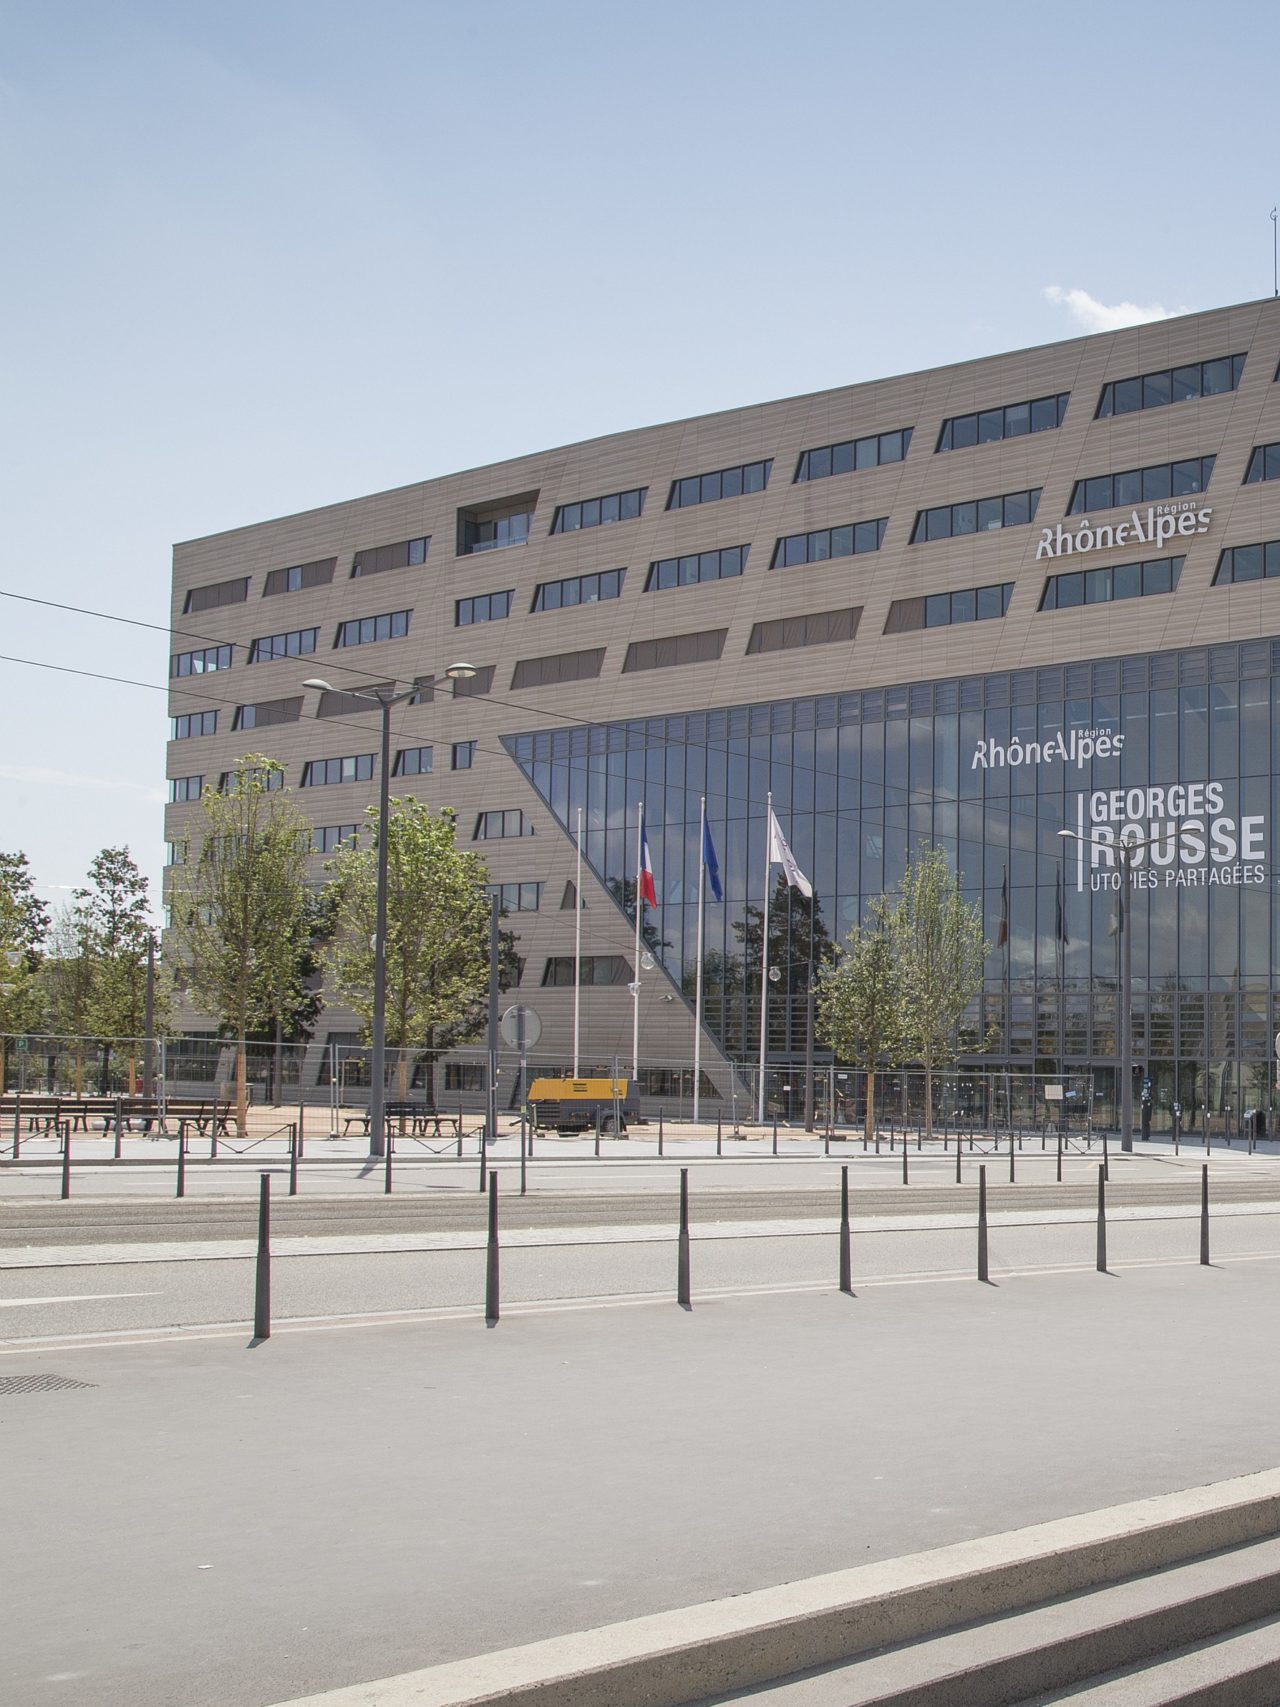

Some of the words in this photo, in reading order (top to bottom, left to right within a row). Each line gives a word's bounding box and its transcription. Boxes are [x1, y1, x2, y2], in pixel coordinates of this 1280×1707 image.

[1156, 501, 1197, 515] Région
[1078, 728, 1112, 739] Région
[1090, 782, 1224, 822] GEORGES
[1091, 815, 1265, 868] ROUSSE
[1091, 870, 1158, 892] UTOIES
[1165, 862, 1265, 888] PARTAGÉES
